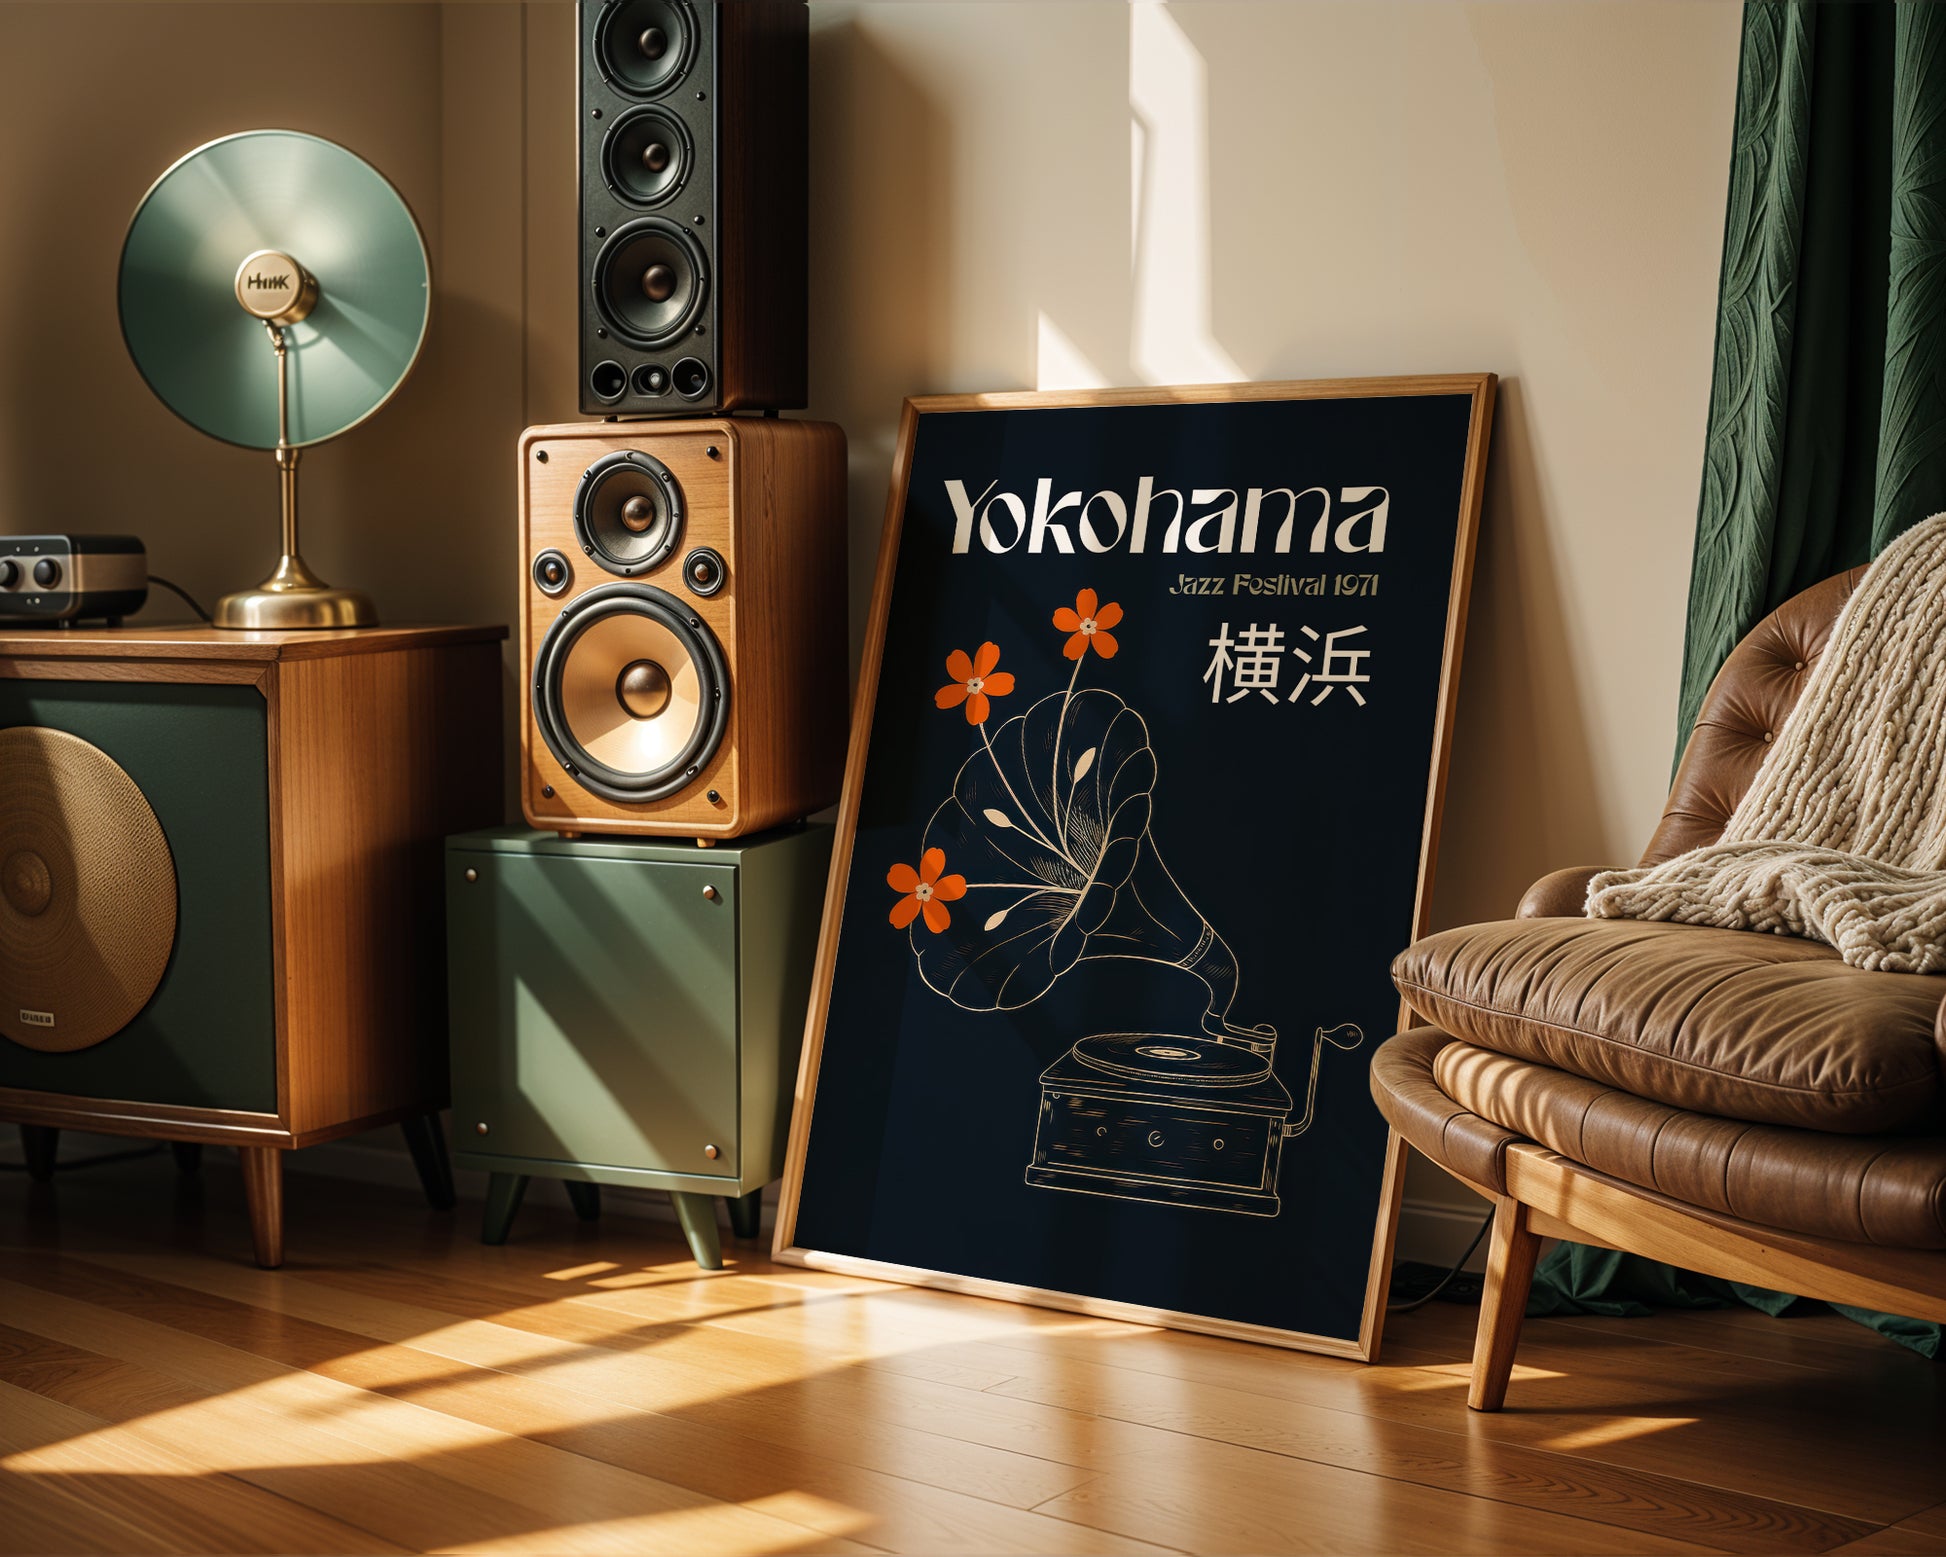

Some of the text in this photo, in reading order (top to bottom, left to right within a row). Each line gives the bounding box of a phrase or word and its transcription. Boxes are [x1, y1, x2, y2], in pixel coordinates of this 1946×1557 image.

[944, 476, 1390, 554] Yokohama
[1169, 573, 1380, 597] Jazz Festival 1971
[1203, 622, 1371, 707] 横浜
